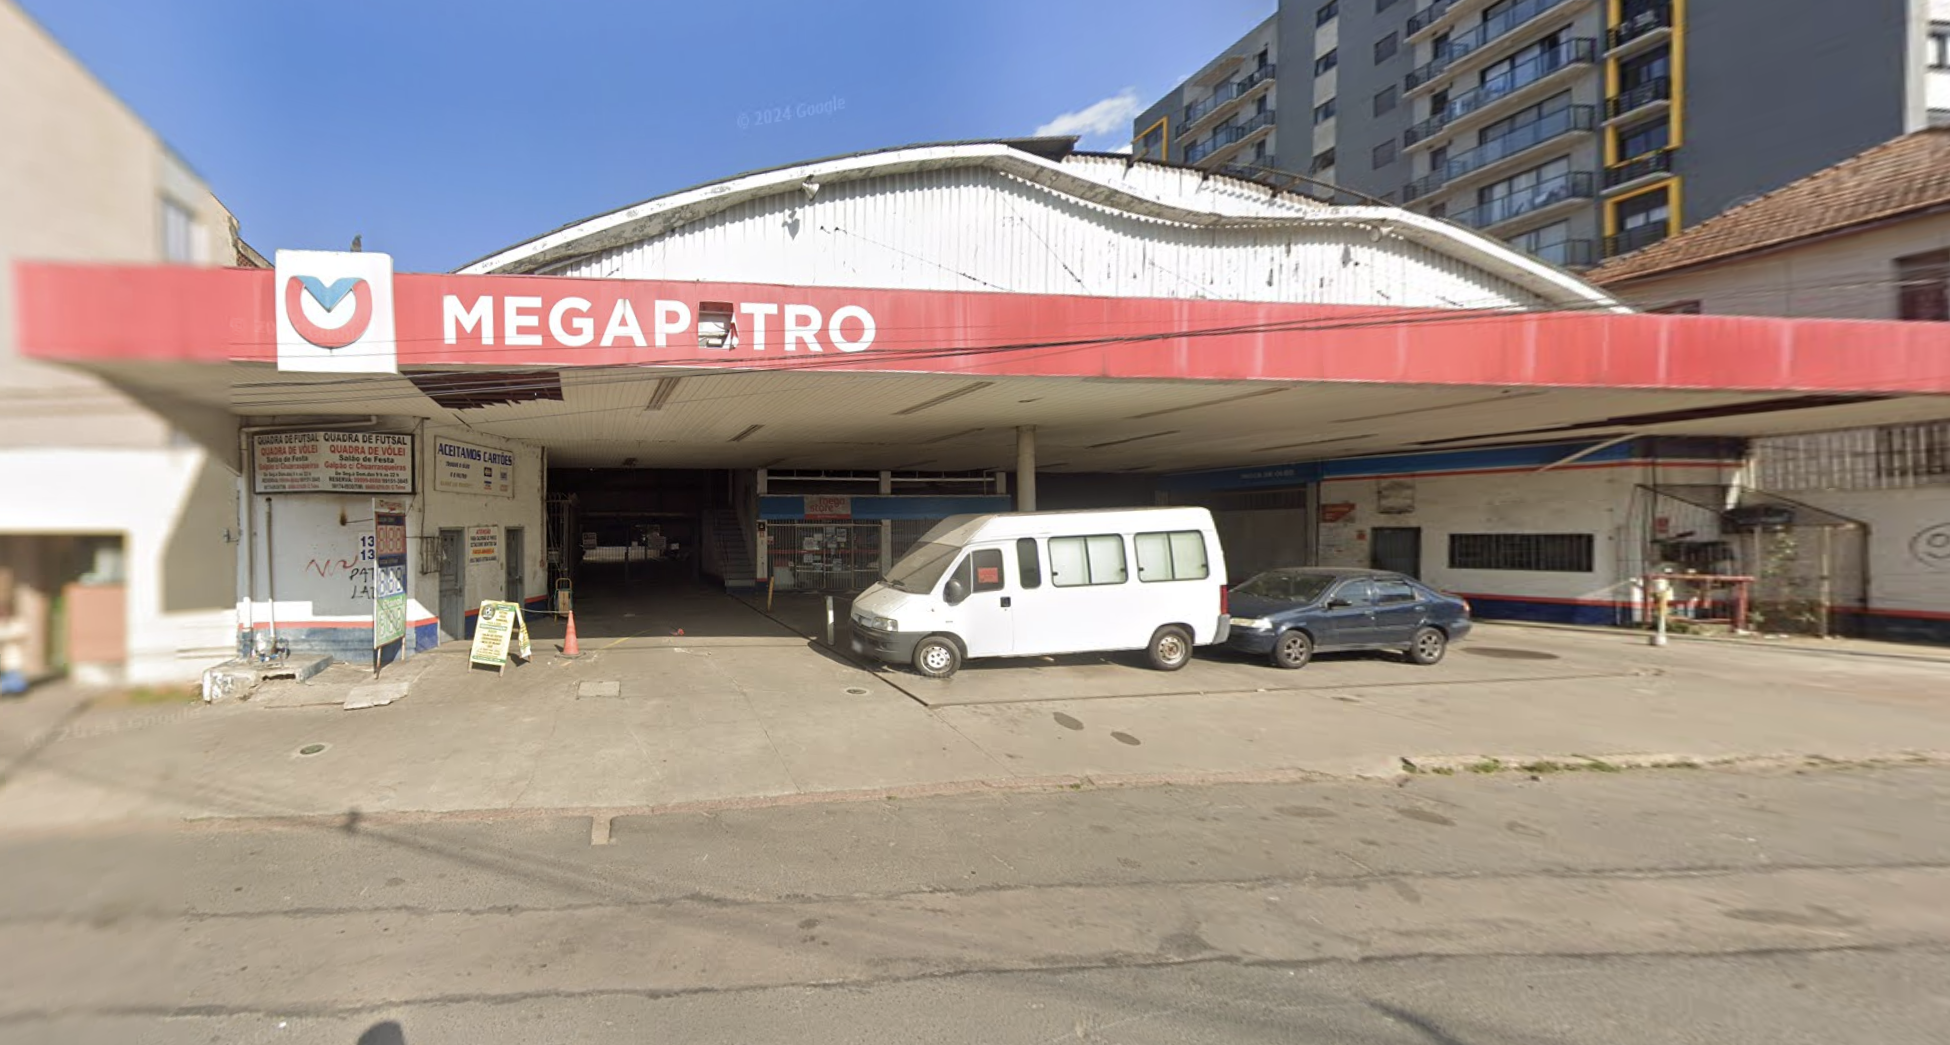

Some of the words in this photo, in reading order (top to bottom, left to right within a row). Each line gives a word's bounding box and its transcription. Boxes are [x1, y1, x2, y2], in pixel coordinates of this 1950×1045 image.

[443, 294, 877, 352] MEGAPTRO
[323, 433, 360, 444] QUADRA
[362, 435, 373, 444] DE
[375, 436, 408, 446] FUTSAL
[329, 444, 367, 455] QUADRA
[369, 446, 380, 455] DE
[381, 445, 406, 456] VÓLEI
[437, 443, 482, 461] ACEITAMOS
[483, 452, 513, 466] CARTÕES
[338, 454, 361, 463] Salão
[362, 455, 373, 463] de
[374, 456, 395, 464] Festa
